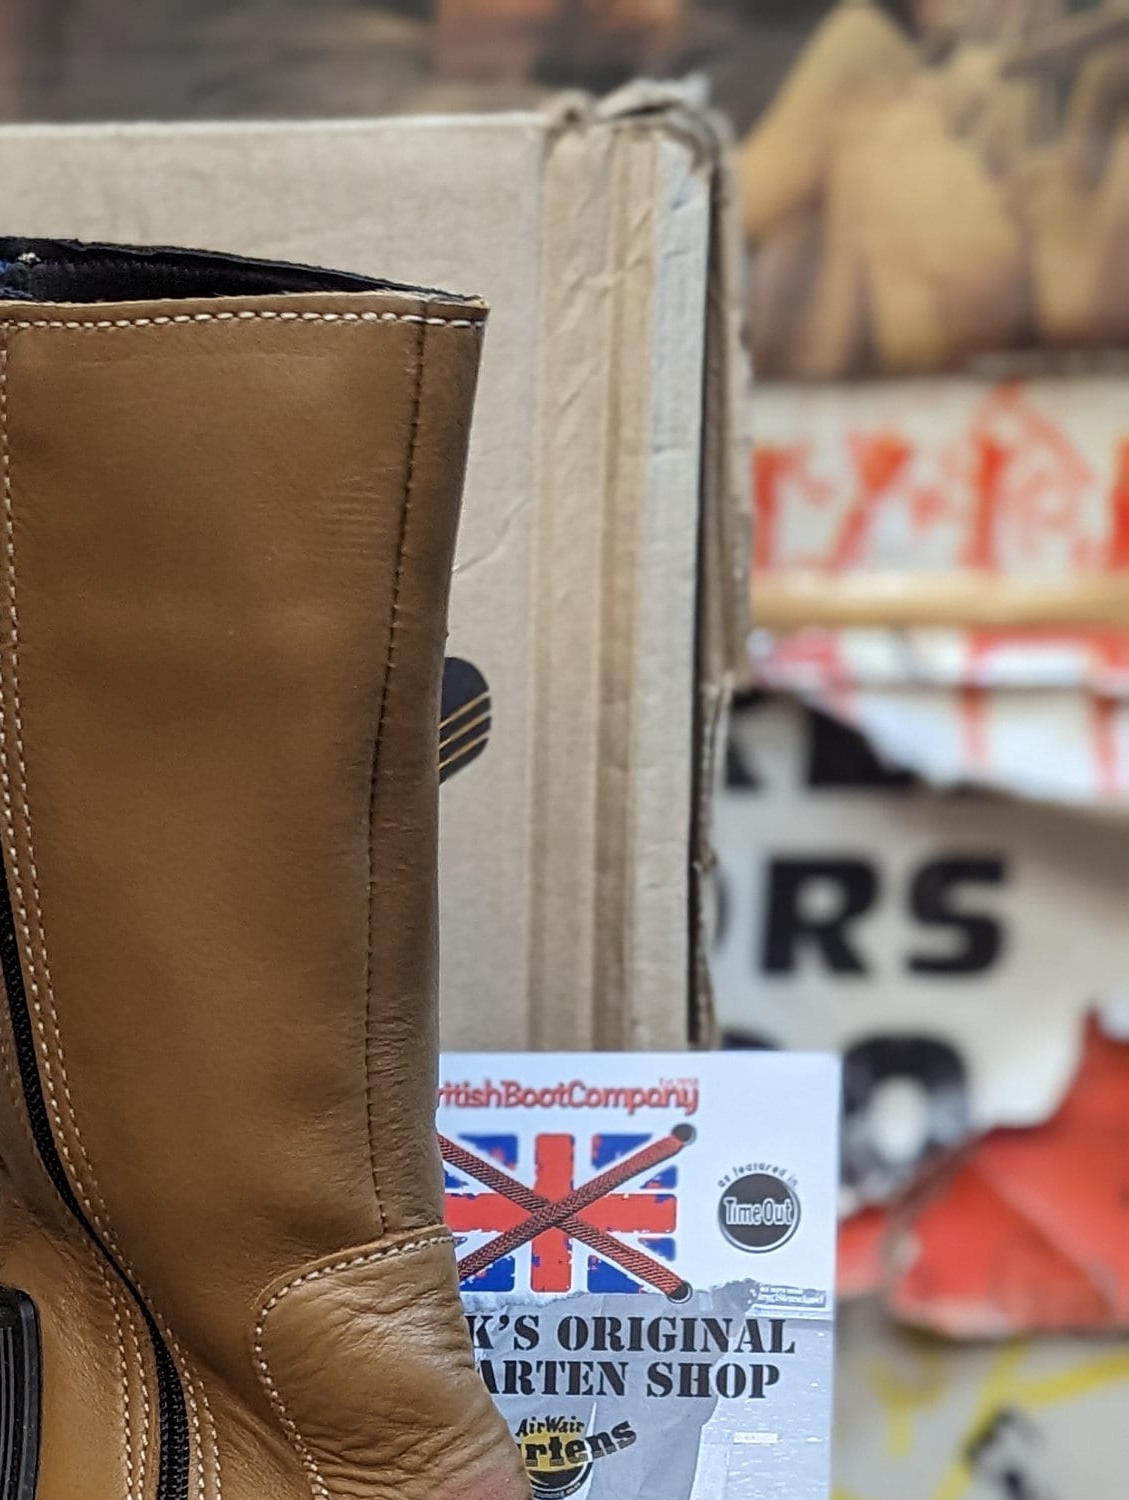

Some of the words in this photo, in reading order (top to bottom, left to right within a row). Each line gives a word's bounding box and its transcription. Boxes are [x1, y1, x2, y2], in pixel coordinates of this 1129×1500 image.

[755, 850, 1010, 982] RS
[724, 1197, 762, 1225] Time
[762, 1198, 793, 1225] Out
[465, 1314, 540, 1351] K'S
[557, 1315, 796, 1354] ORIGINAL
[478, 1359, 629, 1397] ARTEN
[646, 1361, 780, 1399] SHOP
[515, 1414, 586, 1438] AirWair
[517, 1420, 638, 1467] rtens
